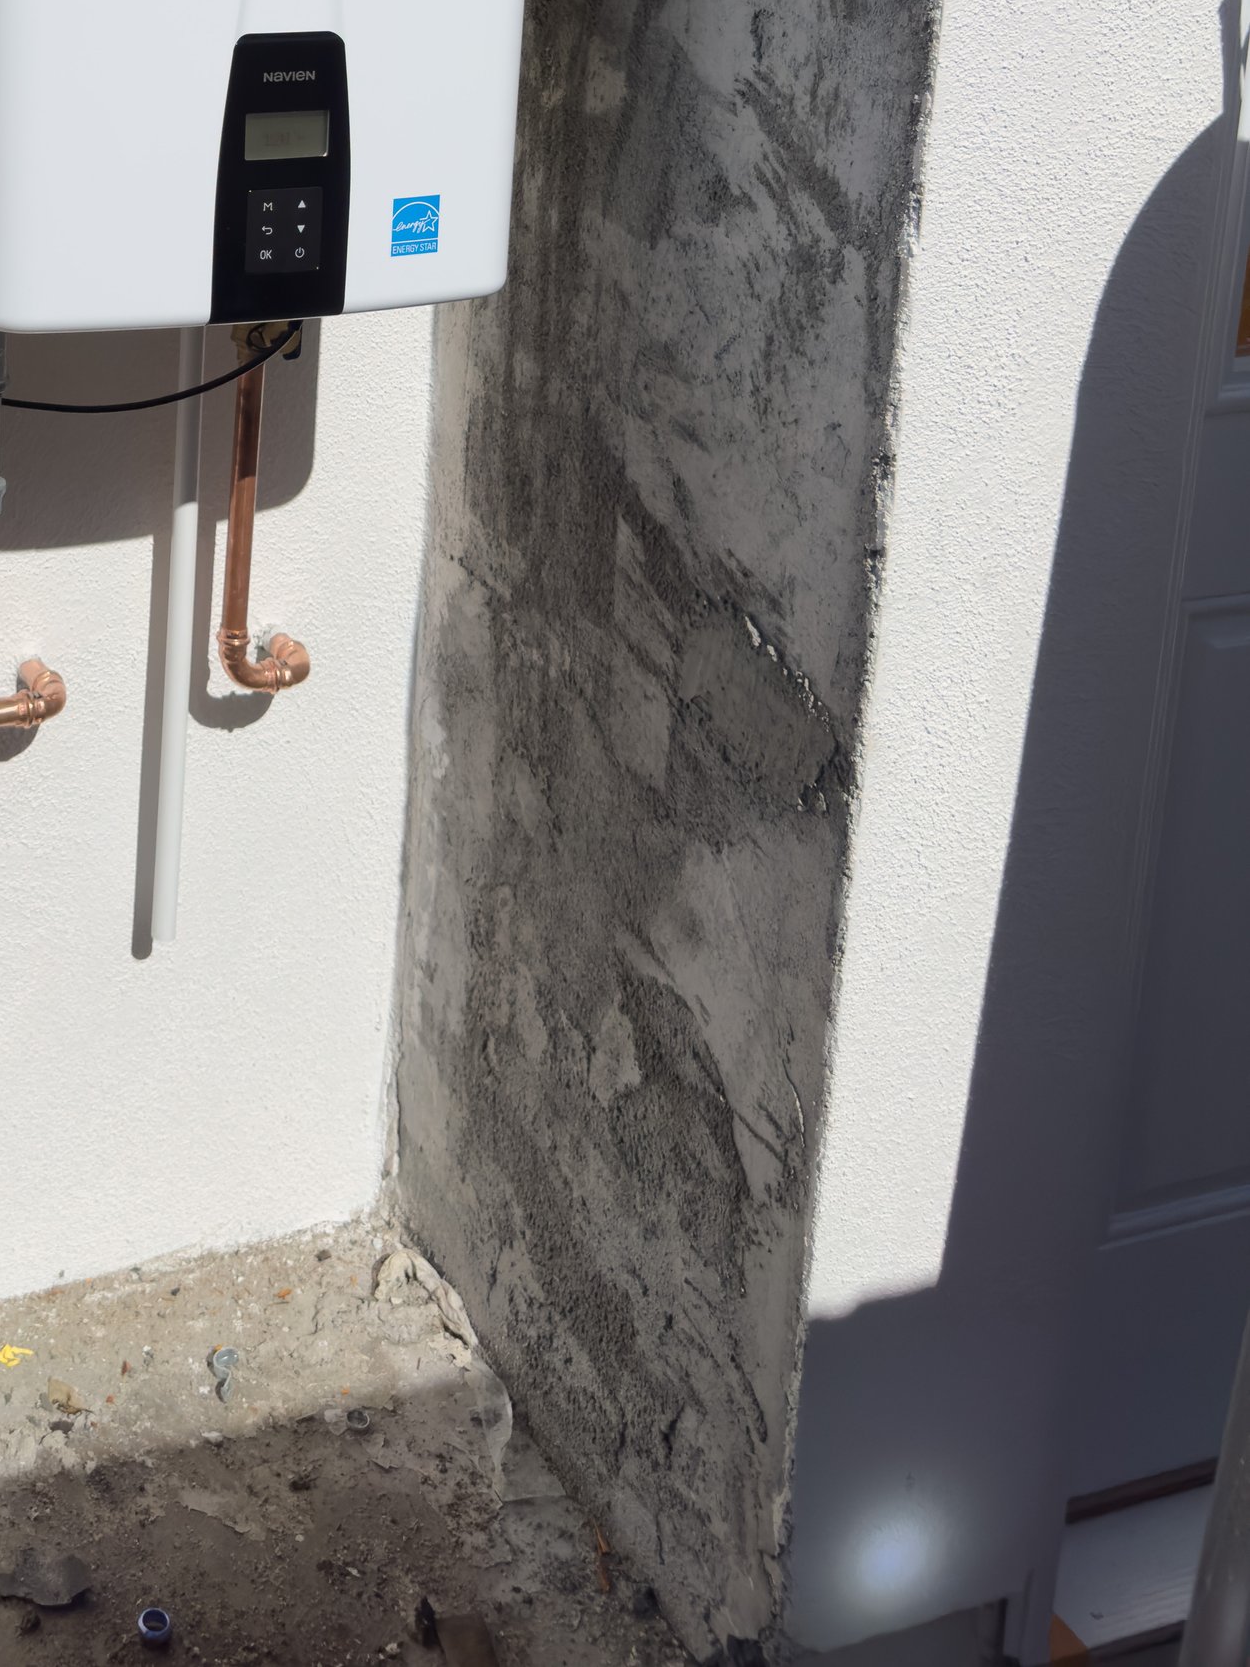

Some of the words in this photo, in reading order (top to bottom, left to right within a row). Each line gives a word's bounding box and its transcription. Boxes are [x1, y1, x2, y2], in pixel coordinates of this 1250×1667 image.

[263, 201, 273, 212] M
[392, 244, 419, 254] ENERGY
[419, 242, 437, 252] STAR
[259, 249, 273, 260] OK
